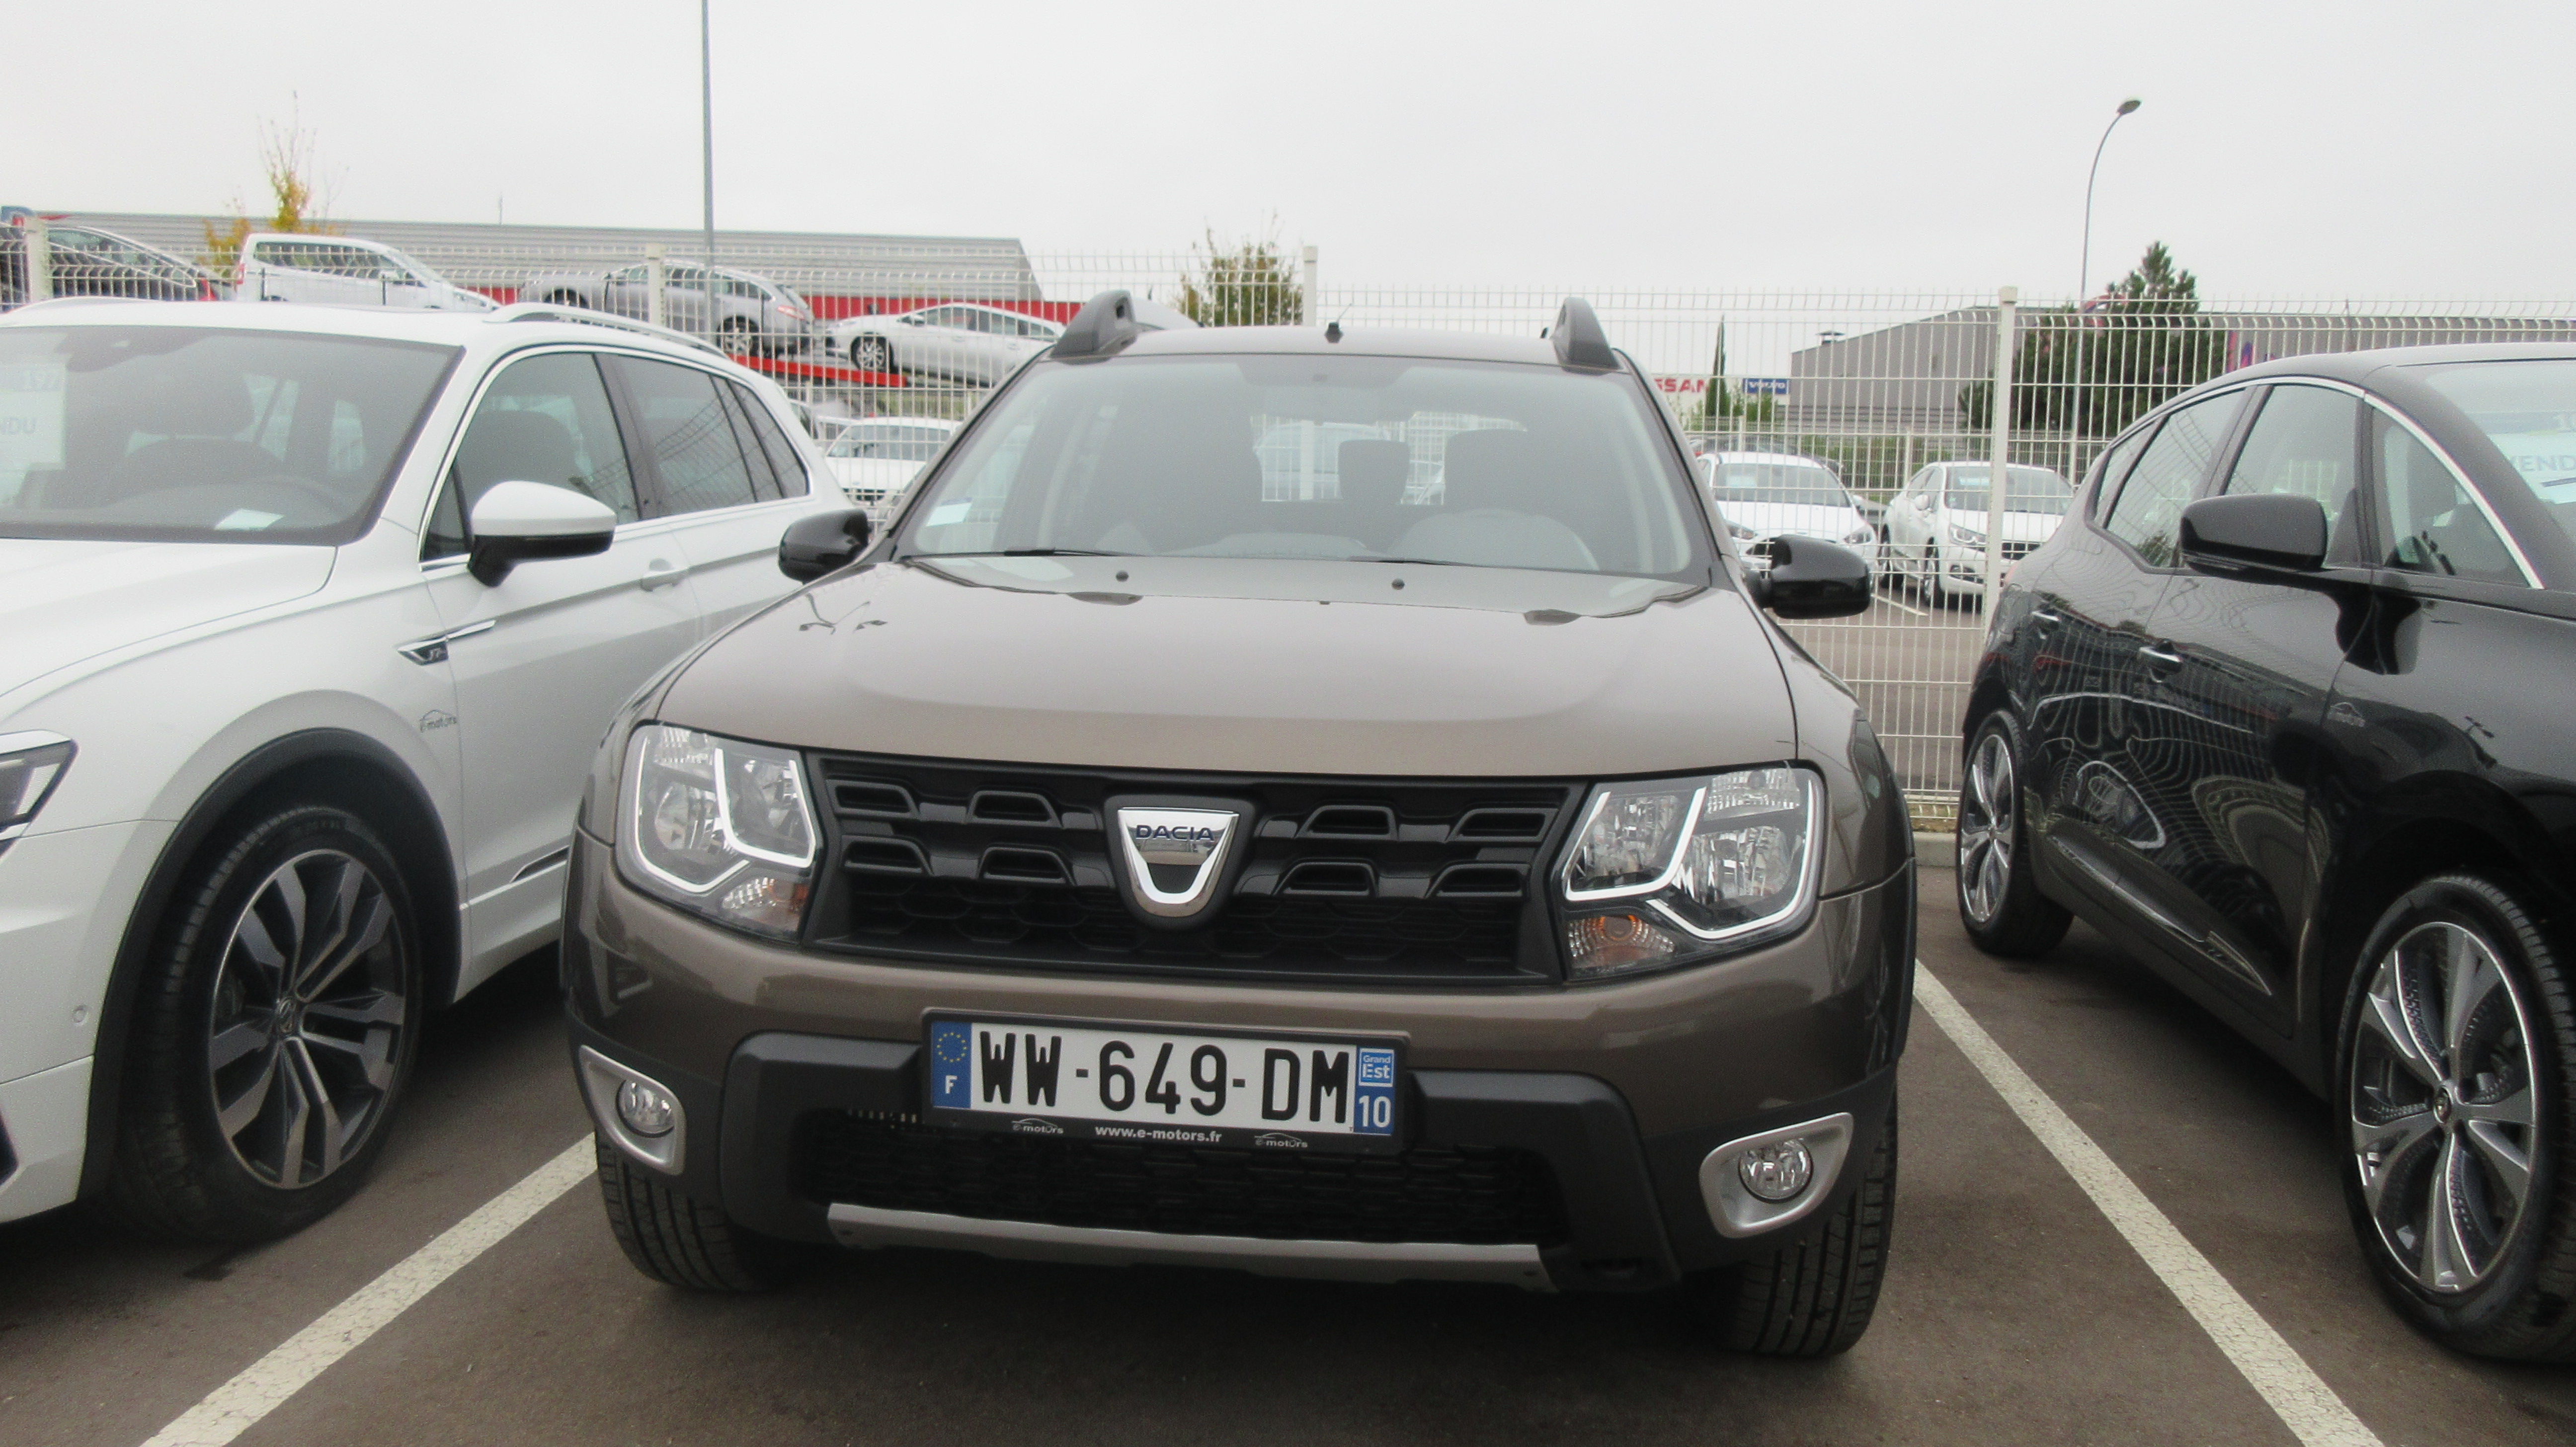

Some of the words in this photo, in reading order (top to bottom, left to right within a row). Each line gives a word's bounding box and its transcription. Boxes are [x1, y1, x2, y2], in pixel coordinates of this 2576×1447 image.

[1136, 824, 1214, 842] DACIA
[1363, 1055, 1391, 1063] Grand
[1363, 1063, 1390, 1079] Est
[946, 1075, 958, 1094] F
[1359, 1095, 1391, 1128] 10
[1095, 1126, 1222, 1142] www.e-motors.fr
